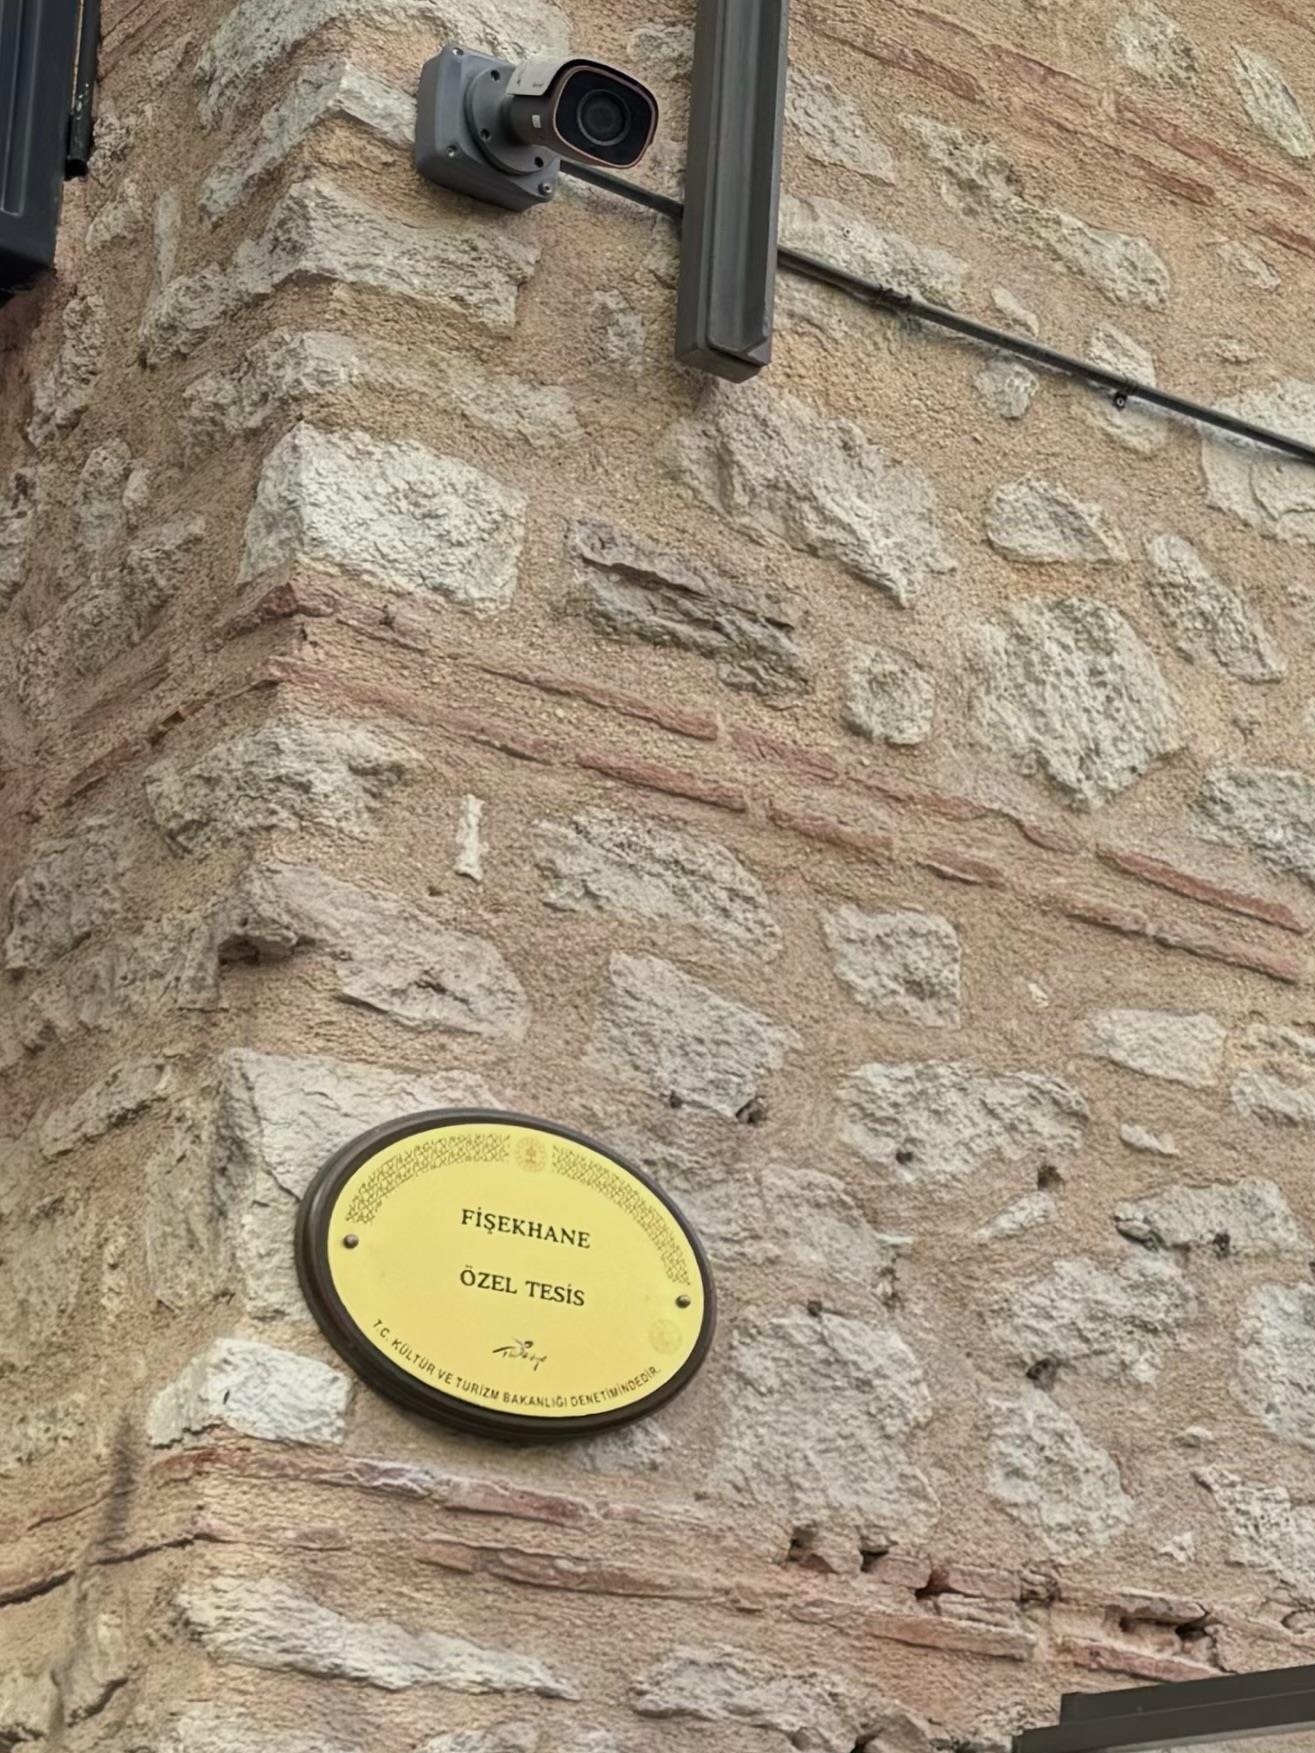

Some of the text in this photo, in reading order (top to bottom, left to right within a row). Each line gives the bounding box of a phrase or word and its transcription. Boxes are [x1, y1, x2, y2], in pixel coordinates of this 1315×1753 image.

[461, 1206, 591, 1249] FİŞEKHANE
[460, 1264, 585, 1307] ÖZEL TESİS
[391, 1338, 436, 1375] KÜLTÜR
[438, 1368, 454, 1385] VE
[456, 1376, 500, 1400] TURİZM
[502, 1393, 568, 1408] BAKANLIĞI
